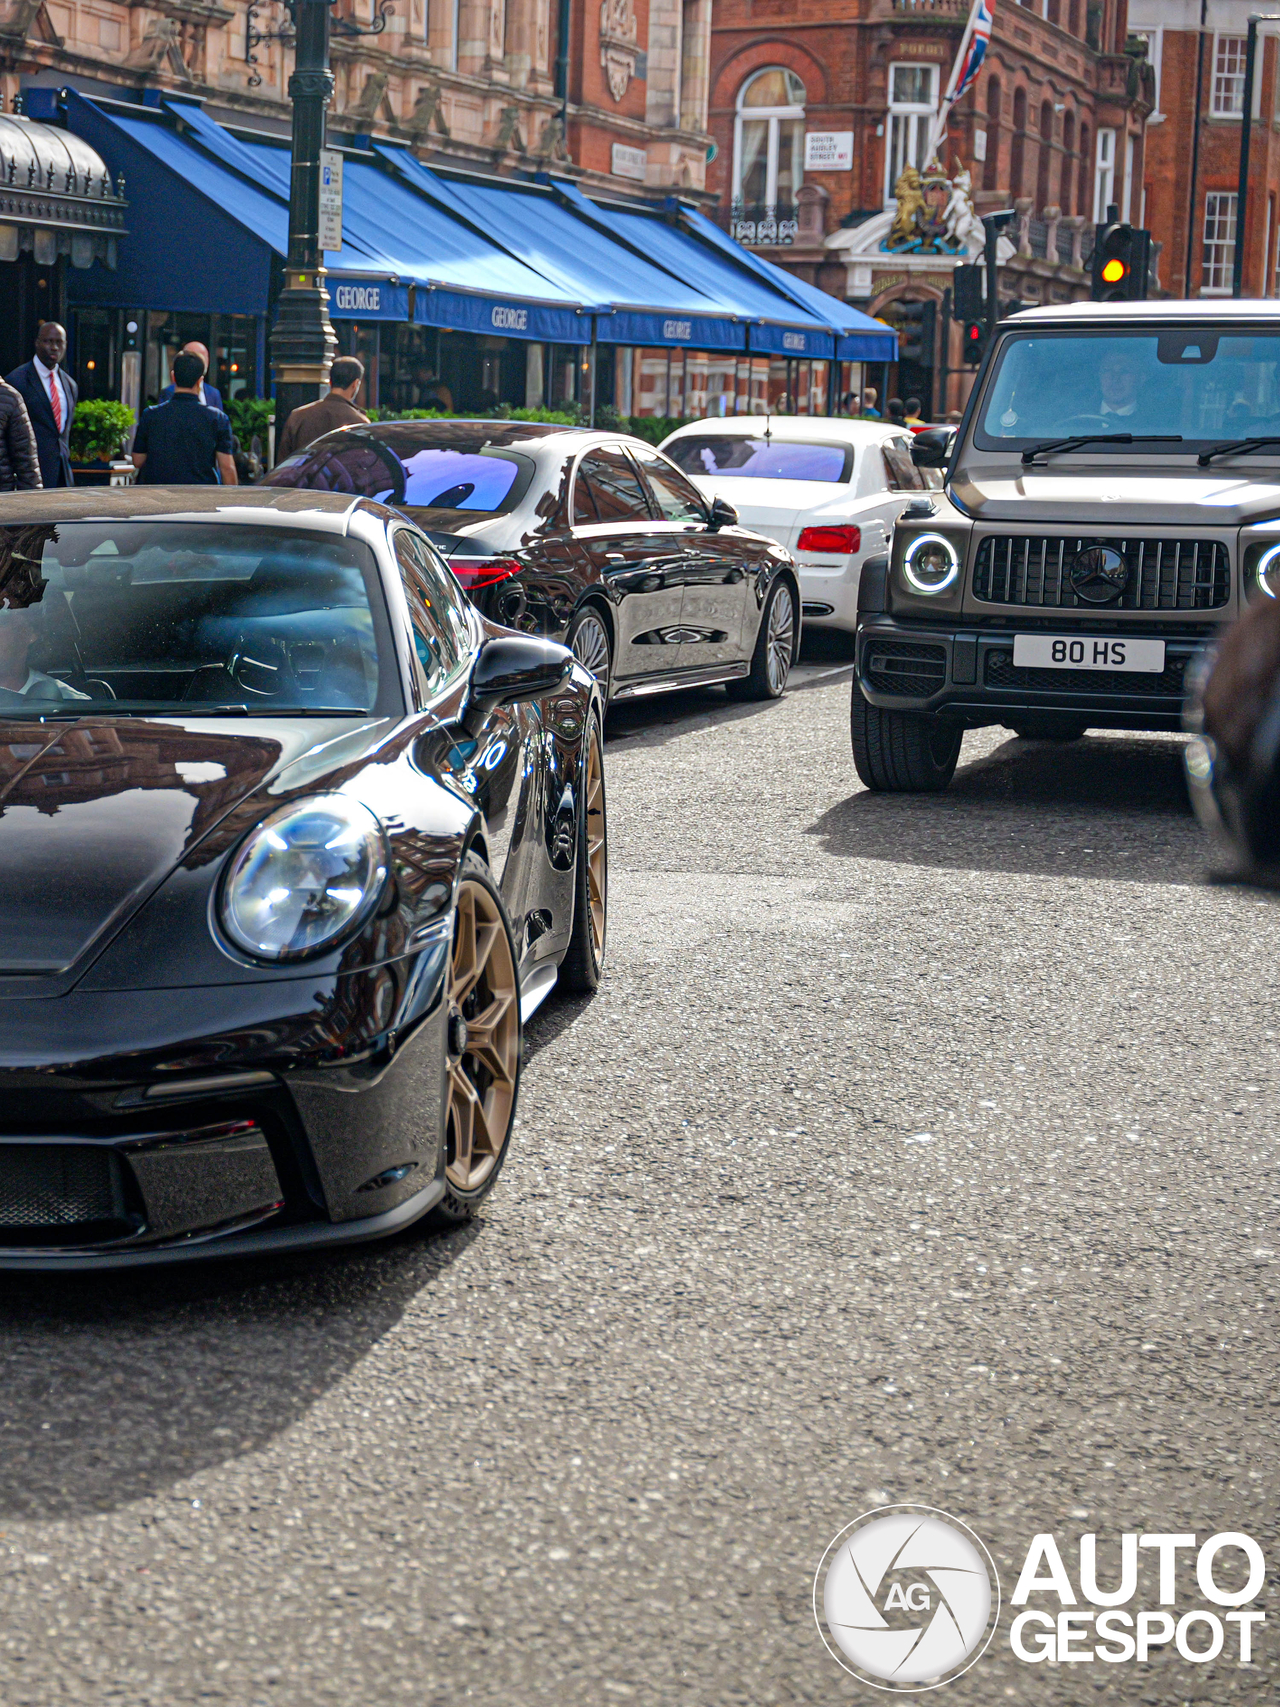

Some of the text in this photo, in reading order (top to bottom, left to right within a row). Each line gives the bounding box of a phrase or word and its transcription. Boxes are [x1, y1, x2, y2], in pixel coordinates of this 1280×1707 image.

[336, 285, 380, 310] GEORGE
[491, 306, 528, 330] GEORGE
[663, 320, 691, 340] GEORGE
[783, 331, 806, 350] GEORGE
[1051, 640, 1126, 665] 80 HS
